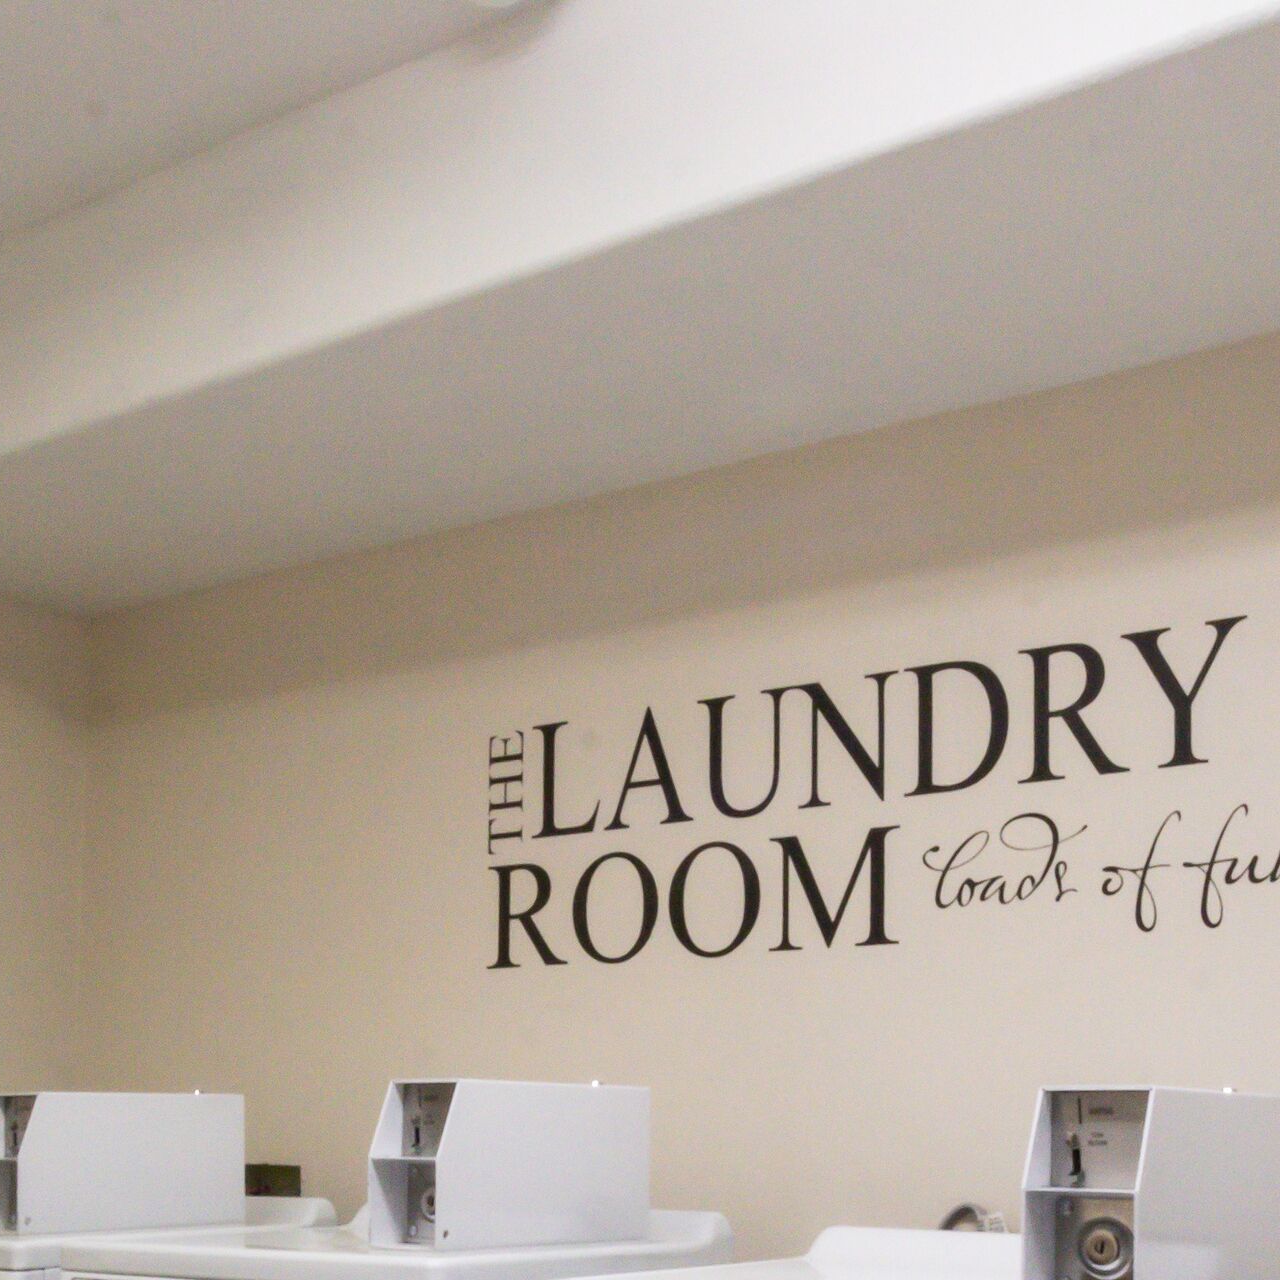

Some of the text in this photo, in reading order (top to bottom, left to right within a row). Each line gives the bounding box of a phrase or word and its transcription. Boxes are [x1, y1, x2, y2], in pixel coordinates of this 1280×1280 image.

[487, 729, 525, 856] THE
[530, 614, 1249, 840] LAUNDRY
[485, 824, 901, 970] ROOM
[922, 811, 1089, 910] loads
[1100, 808, 1183, 934] of
